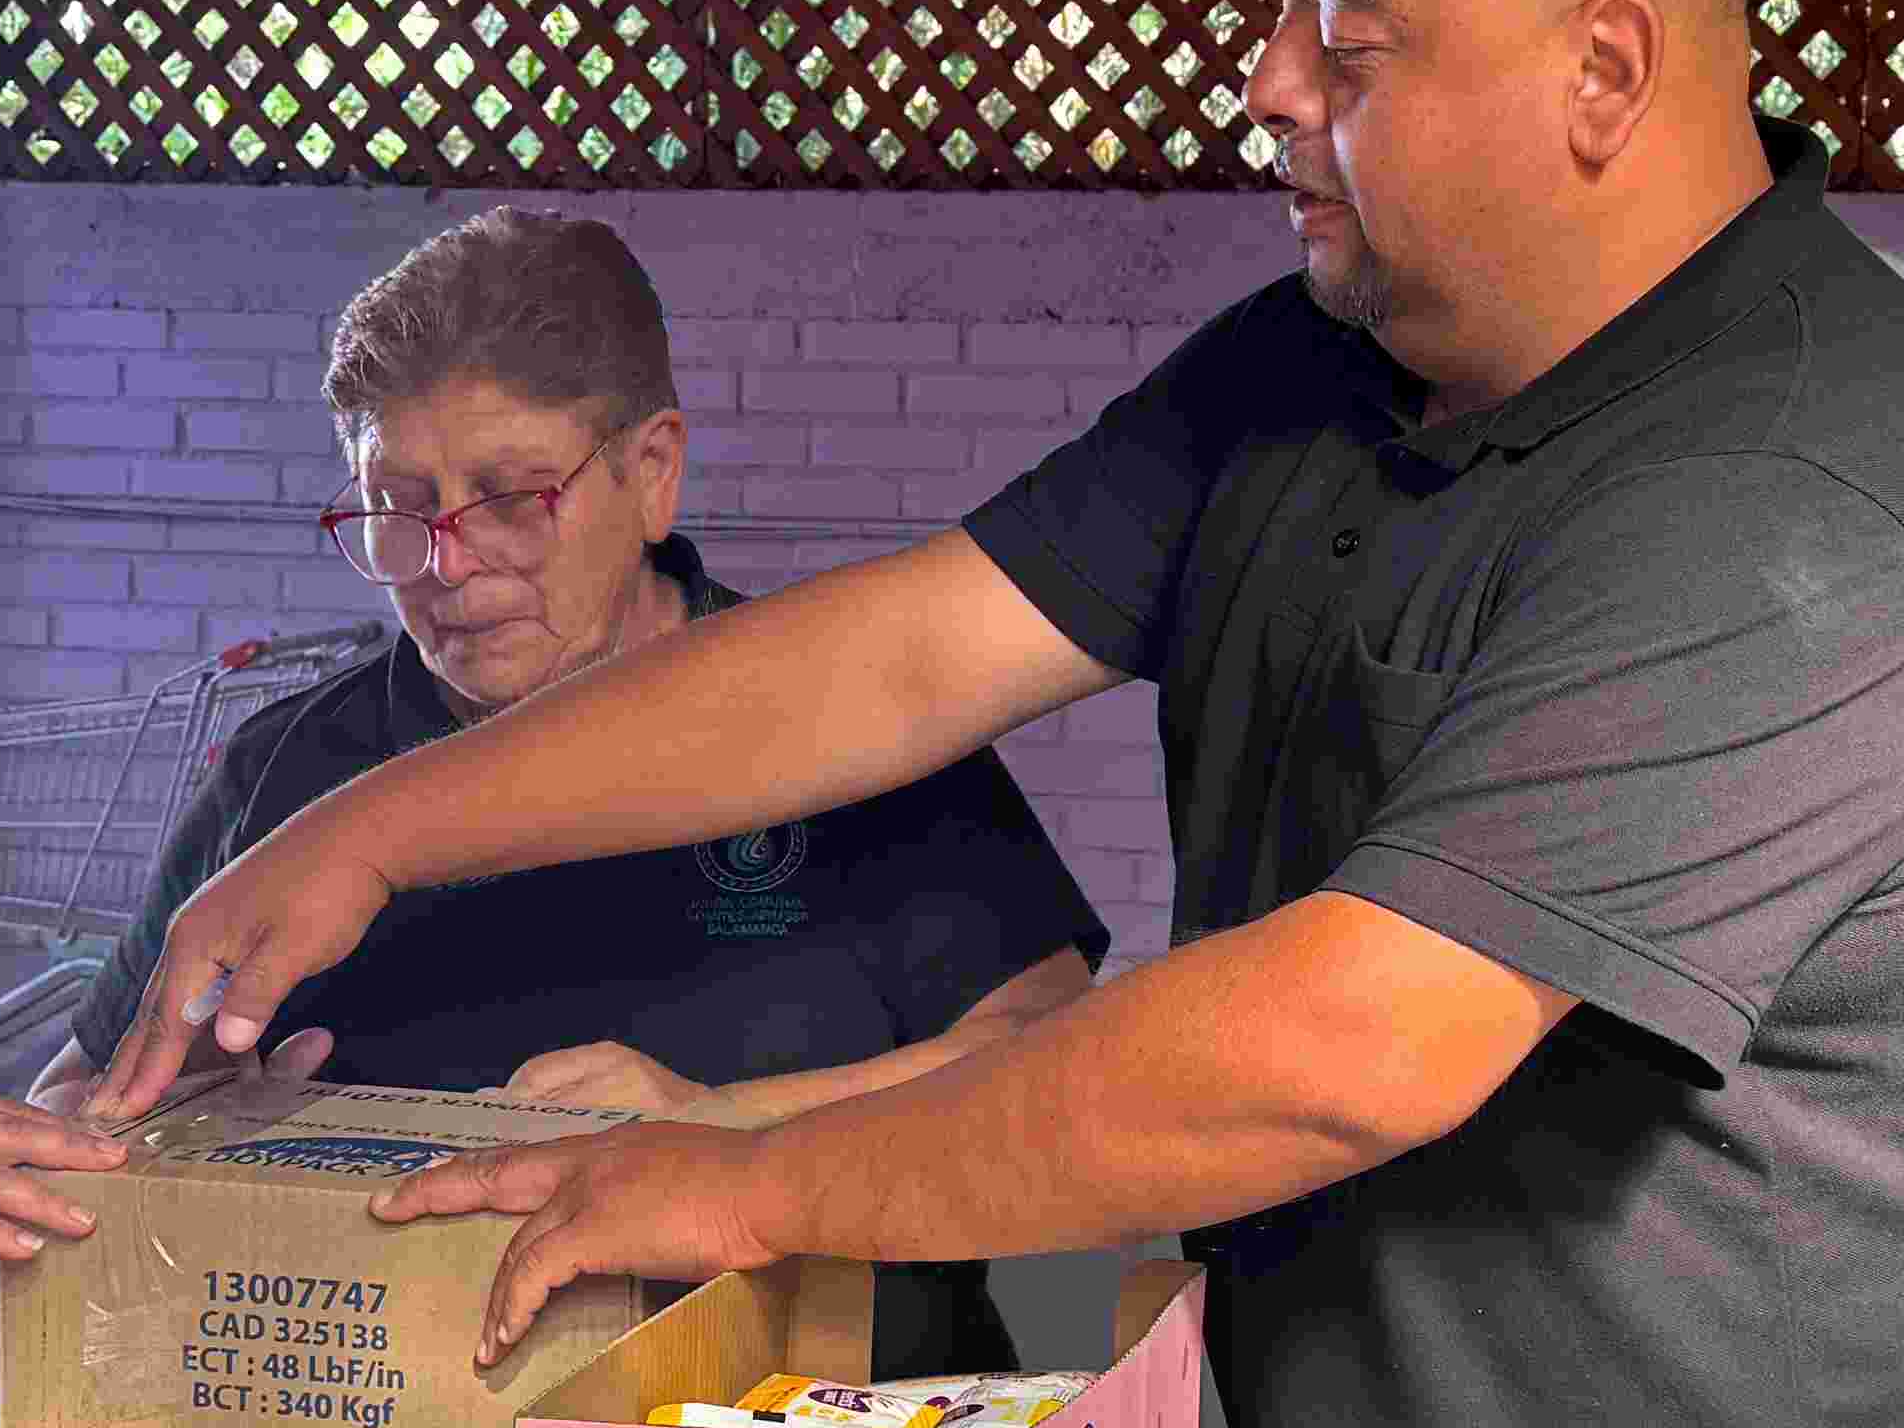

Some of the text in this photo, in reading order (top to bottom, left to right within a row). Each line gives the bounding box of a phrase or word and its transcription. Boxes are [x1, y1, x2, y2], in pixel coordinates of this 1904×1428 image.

[205, 1148, 369, 1176] DOYPACK
[203, 1271, 388, 1313] 13007747
[200, 1312, 388, 1351] CAD 325138
[183, 1344, 240, 1375] ECT
[262, 1352, 300, 1381] 48
[309, 1356, 405, 1391] LbF/in
[193, 1382, 252, 1413] BCT
[278, 1390, 333, 1420] 340
